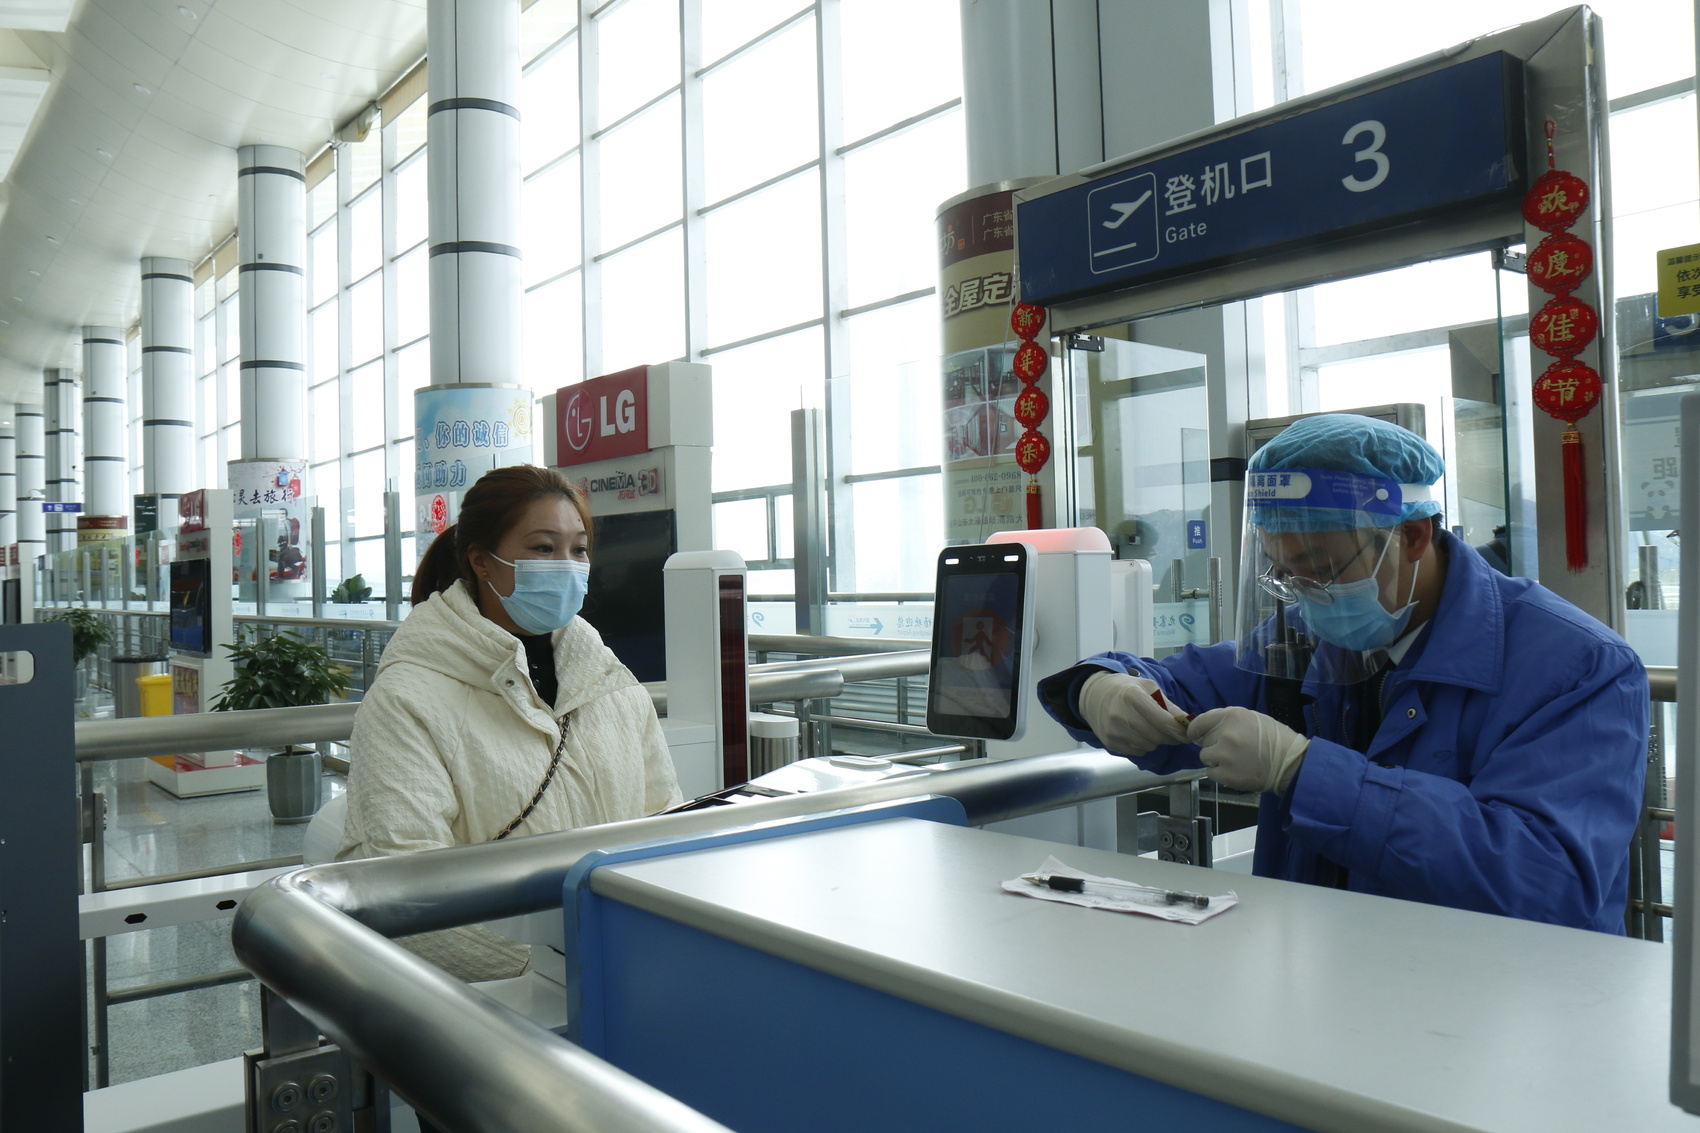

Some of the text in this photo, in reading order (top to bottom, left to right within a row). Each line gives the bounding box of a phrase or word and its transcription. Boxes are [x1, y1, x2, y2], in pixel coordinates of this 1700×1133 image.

[1341, 119, 1390, 193] 3
[1164, 151, 1272, 216] 登机口
[1165, 221, 1207, 244] Gate
[944, 272, 1014, 319] 全屋定
[600, 389, 636, 437] LG
[233, 489, 294, 505] 灵去旅行
[590, 472, 635, 493] CINEMA
[638, 468, 658, 497] 3D
[1254, 489, 1276, 497] Shield
[1194, 525, 1202, 537] 推
